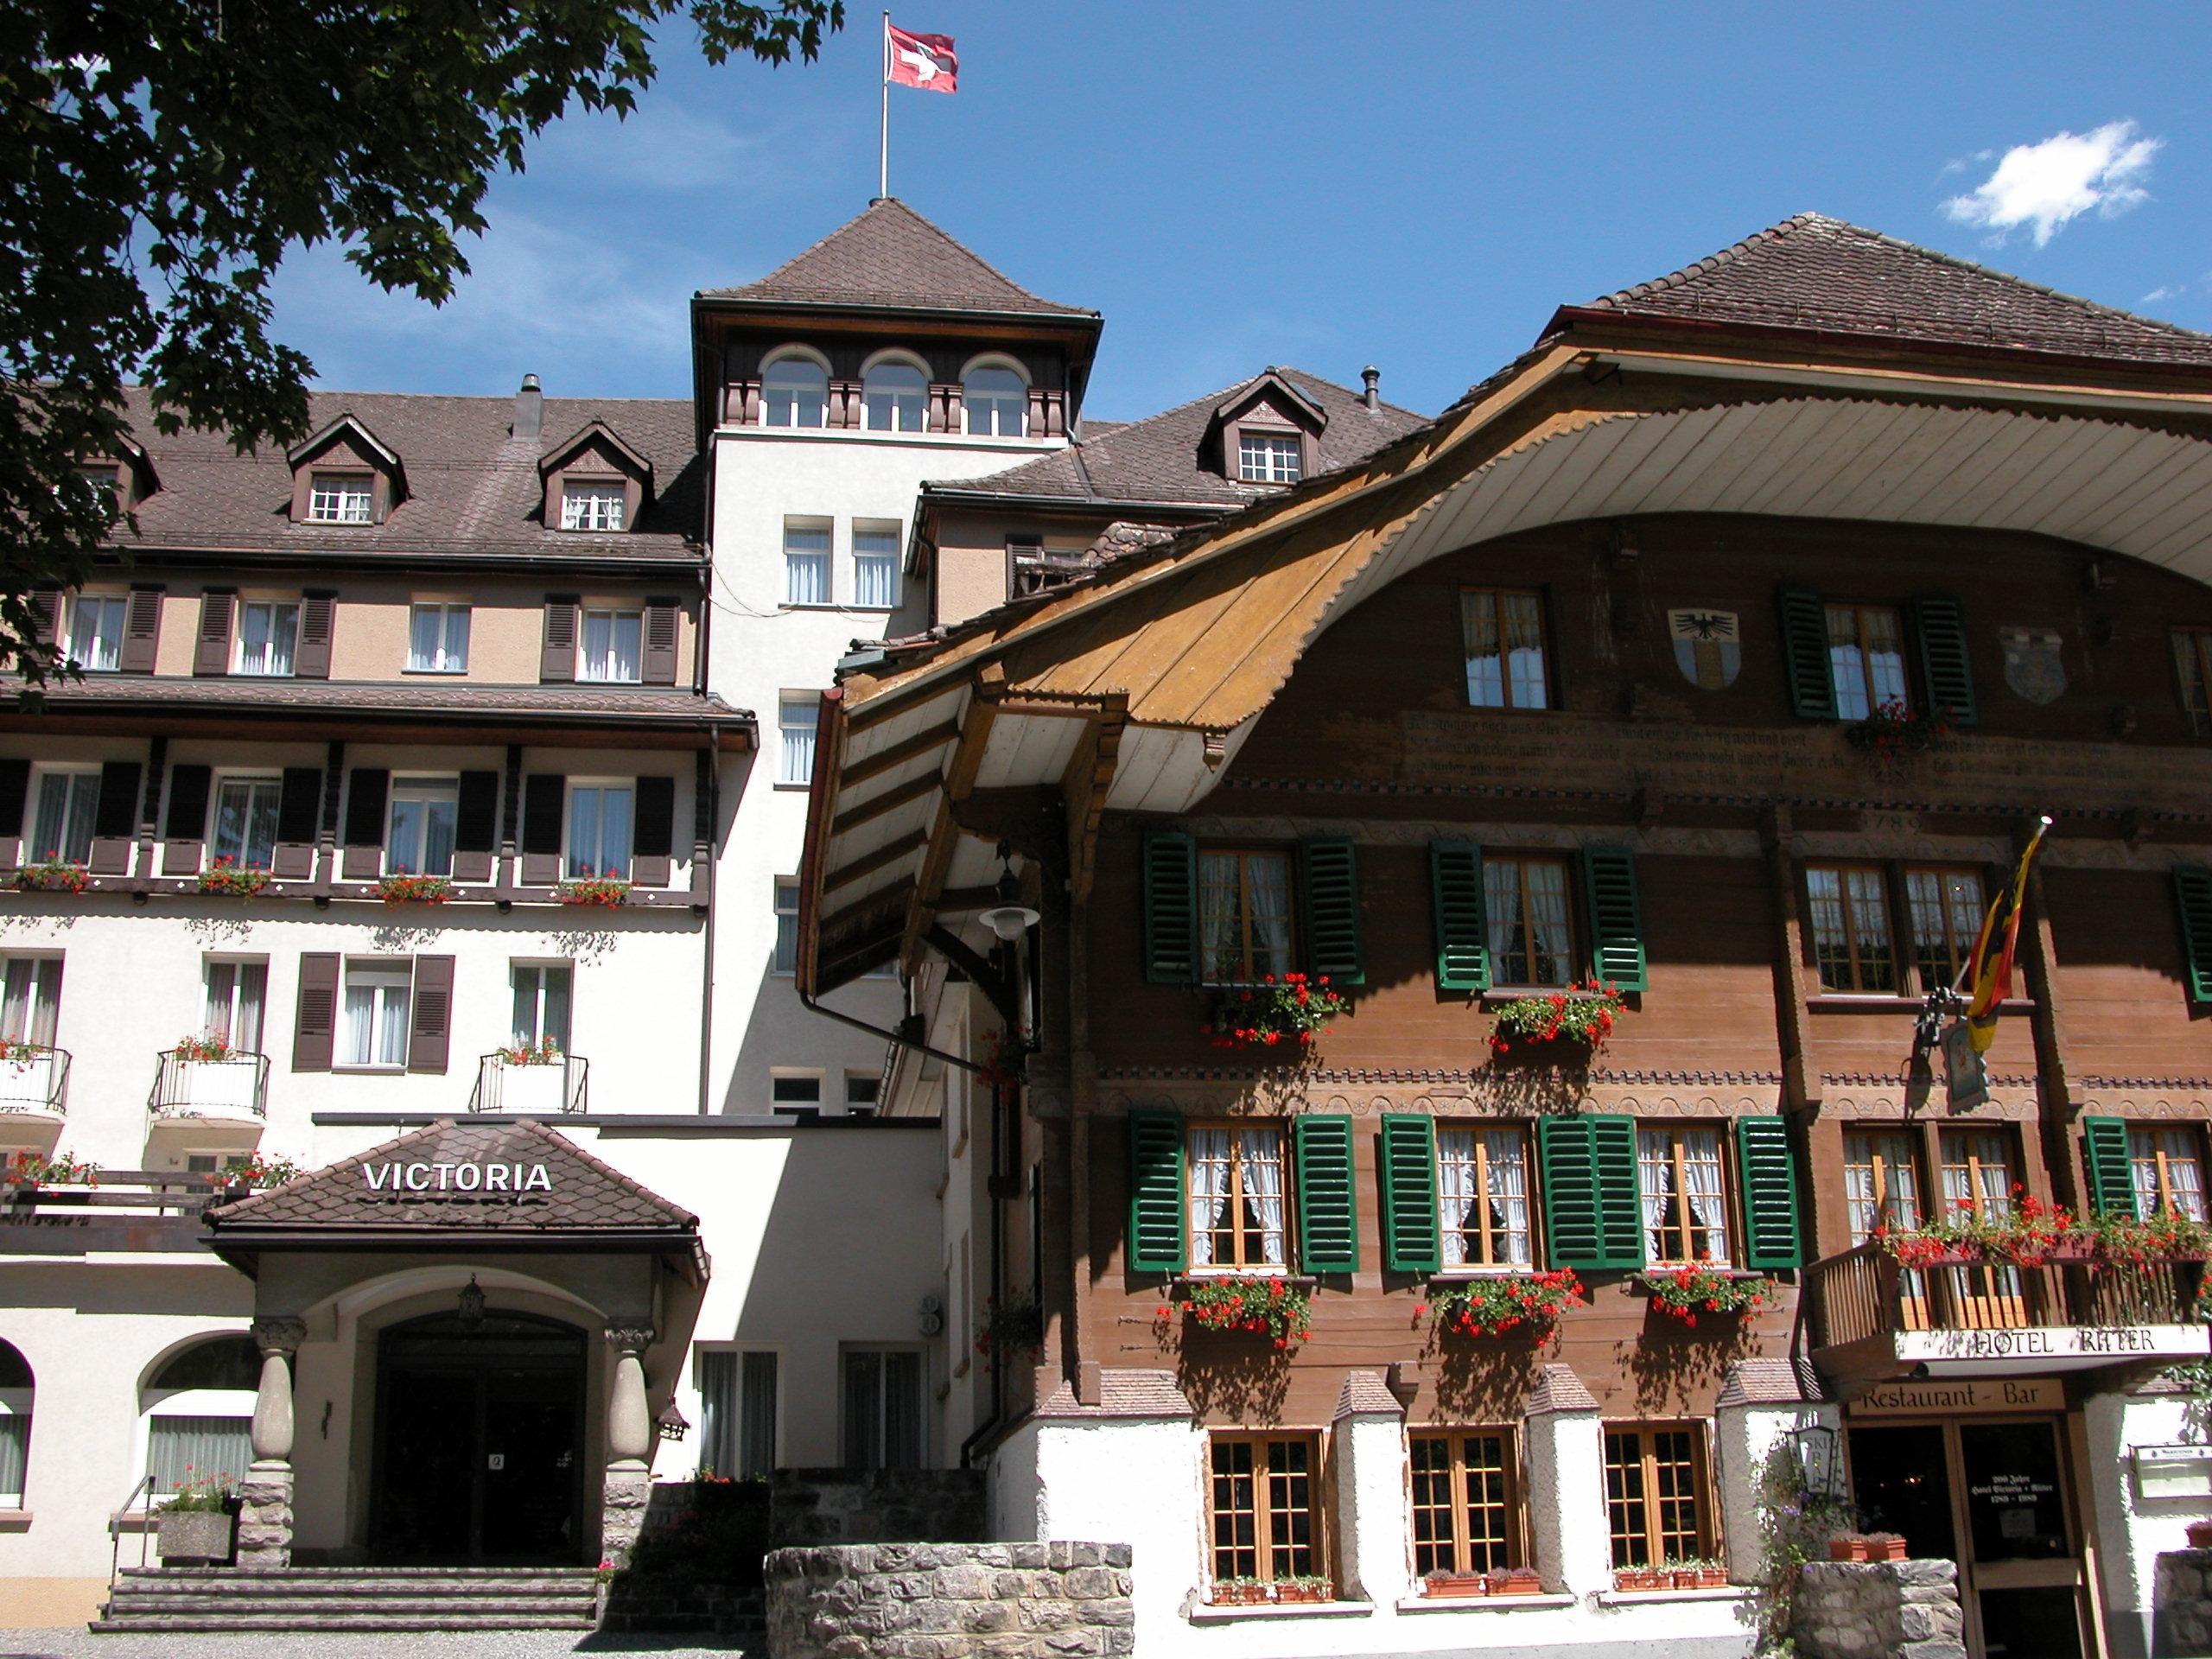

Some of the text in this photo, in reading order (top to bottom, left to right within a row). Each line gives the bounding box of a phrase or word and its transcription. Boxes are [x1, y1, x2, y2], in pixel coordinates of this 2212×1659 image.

[1864, 815, 1922, 836] 1789
[363, 1163, 552, 1192] VICTORIA
[1975, 1329, 2155, 1354] HOTEL RITTER
[1862, 1383, 1977, 1408] Restaurant
[2005, 1384, 2039, 1405] Bar
